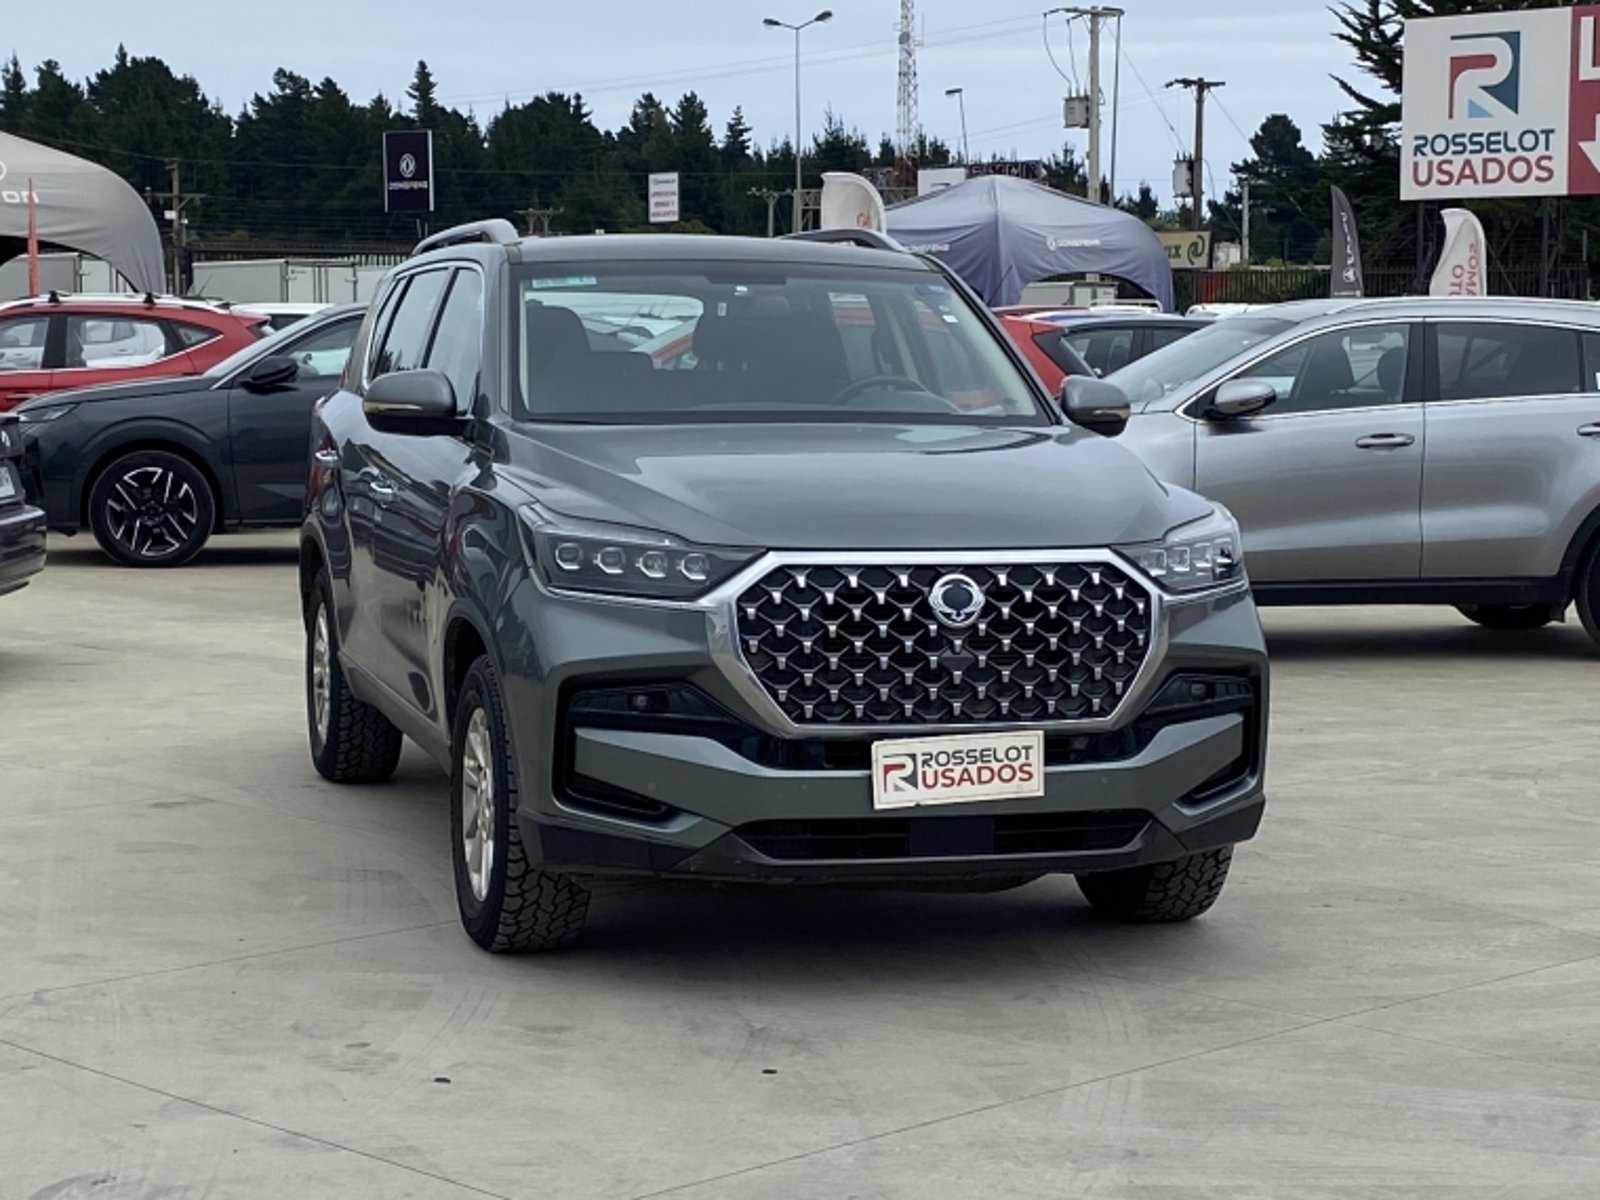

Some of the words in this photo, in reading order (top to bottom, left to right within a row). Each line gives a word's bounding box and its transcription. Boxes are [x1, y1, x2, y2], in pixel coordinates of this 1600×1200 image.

[1412, 128, 1556, 158] ROSSELOT
[1411, 154, 1555, 188] USADOS
[921, 744, 1034, 769] ROSSELOT
[921, 762, 1034, 790] USADOS
